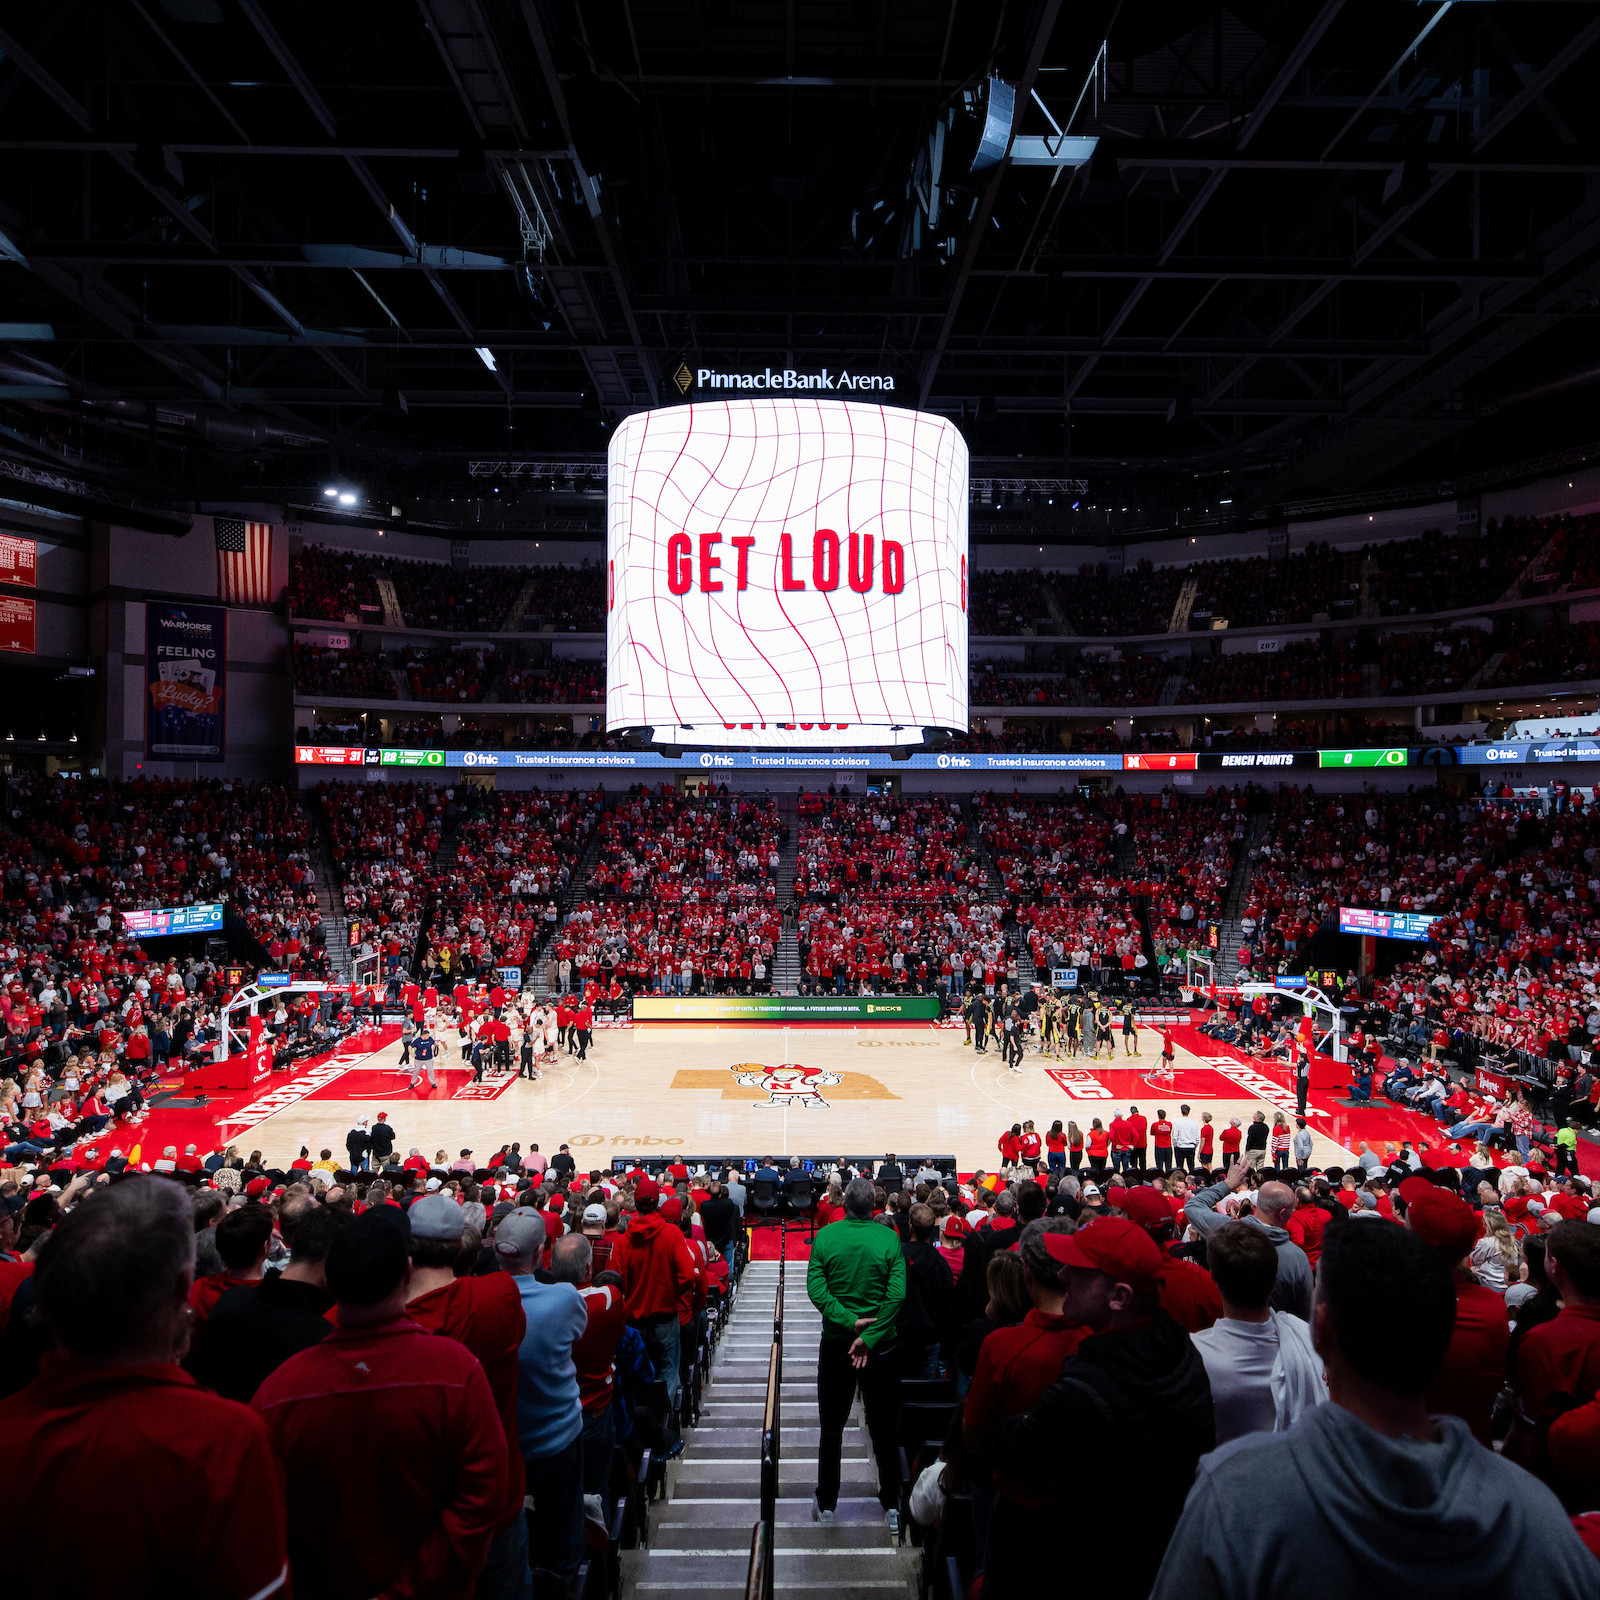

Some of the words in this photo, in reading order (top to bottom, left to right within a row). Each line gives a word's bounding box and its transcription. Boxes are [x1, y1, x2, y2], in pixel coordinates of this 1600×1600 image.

[697, 368, 834, 389] PinnacleBank
[836, 371, 895, 390] Arena
[1270, 535, 1285, 543] 307
[667, 532, 756, 595] GET
[780, 528, 905, 594] LOUD
[160, 618, 213, 631] WARHORSE
[157, 645, 216, 659] FEELING
[158, 684, 215, 710] Lucky?
[299, 749, 314, 761] N
[349, 750, 362, 762] 31
[383, 752, 397, 762] 28
[1386, 750, 1404, 764] O
[1499, 749, 1518, 759] fnic
[1533, 748, 1568, 757] Trusted
[427, 753, 443, 764] O
[477, 753, 499, 765] fnic
[515, 755, 549, 764] Trusted
[550, 755, 595, 764] insurance
[597, 755, 636, 764] advisors
[714, 754, 735, 766] fnic
[751, 756, 784, 766] Trusted
[786, 756, 830, 766] insurance
[832, 756, 870, 766] advisors
[951, 756, 971, 767] fnic
[987, 757, 1021, 767] Trusted
[1023, 757, 1066, 767] insurance
[1068, 757, 1106, 767] advisors
[1127, 756, 1140, 768] N
[1169, 757, 1176, 767] 6
[1221, 755, 1255, 766] BENCH
[1256, 754, 1293, 766] POINTS
[1344, 753, 1353, 764] 0
[369, 771, 385, 779] 104
[1502, 771, 1522, 779] 110
[156, 916, 166, 925] 31
[173, 915, 185, 924] 28
[211, 912, 221, 921] O
[1341, 914, 1350, 924] N
[1377, 918, 1387, 927] 31
[1393, 920, 1405, 929] 28
[350, 931, 359, 945] 30
[230, 976, 239, 984] 30
[1323, 978, 1333, 986] 30
[257, 1055, 266, 1072] C
[253, 1069, 271, 1083] Channel
[215, 1052, 376, 1126] NEBRASKA
[610, 1134, 685, 1146] fnbo
[1027, 1134, 1038, 1145] N
